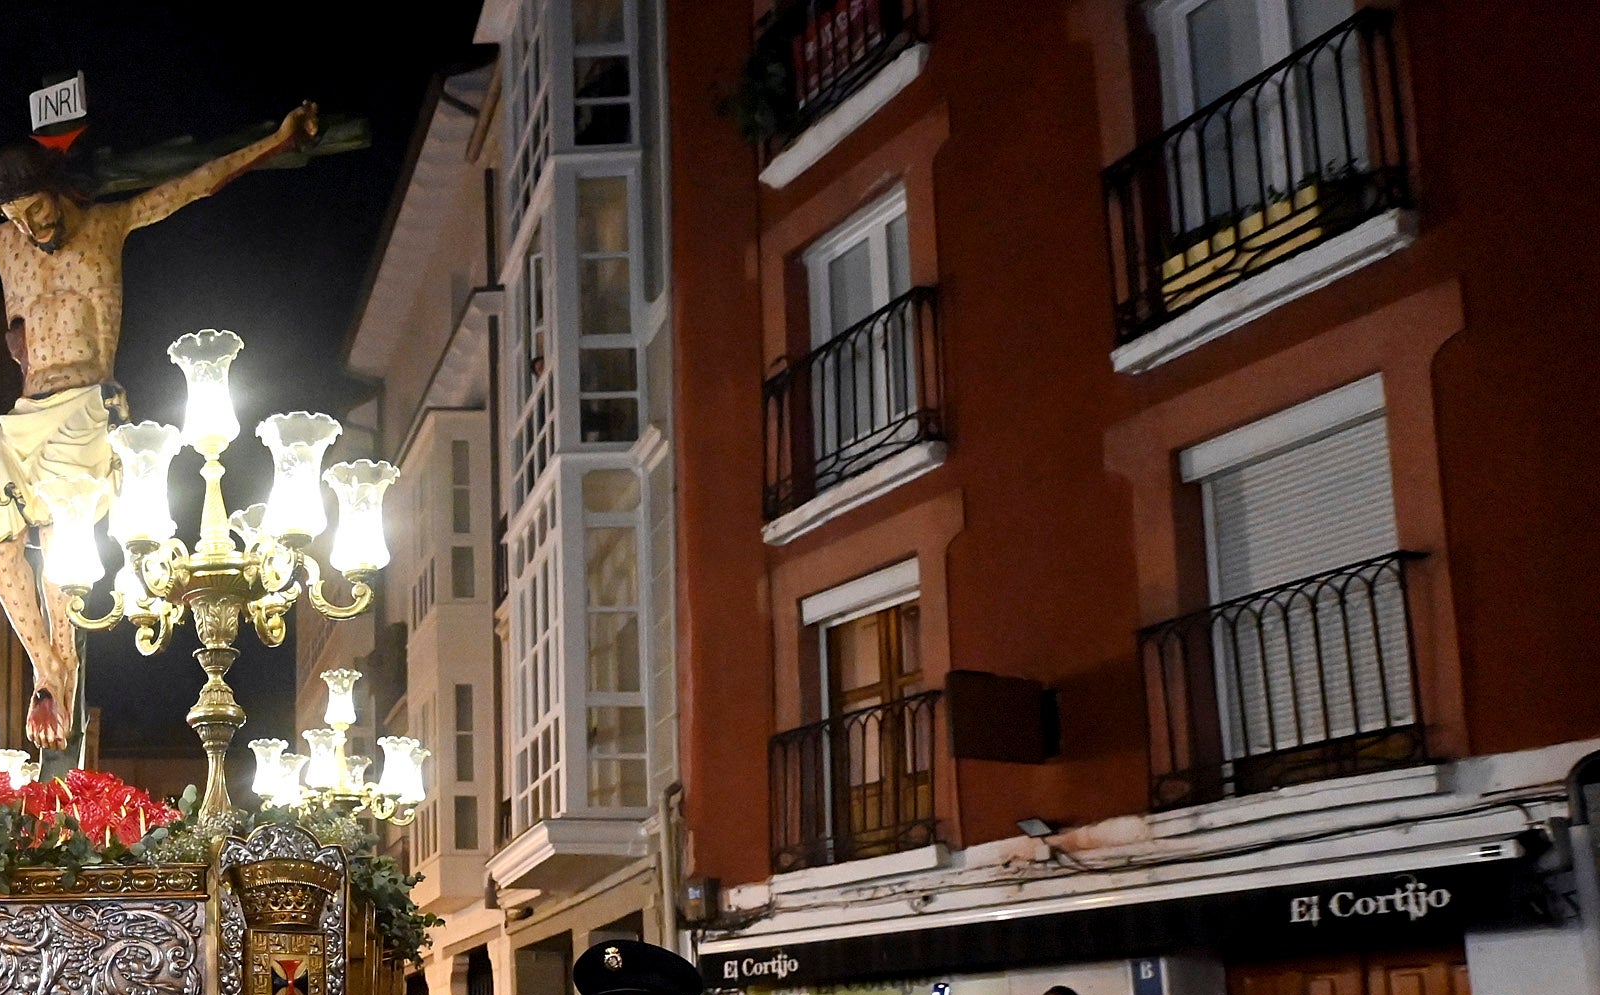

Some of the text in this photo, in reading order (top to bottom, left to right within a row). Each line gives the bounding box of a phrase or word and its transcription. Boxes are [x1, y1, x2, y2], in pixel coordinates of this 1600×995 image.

[38, 83, 77, 122] INRI
[1290, 880, 1452, 926] El Cortijo
[723, 952, 799, 980] El Cortijo
